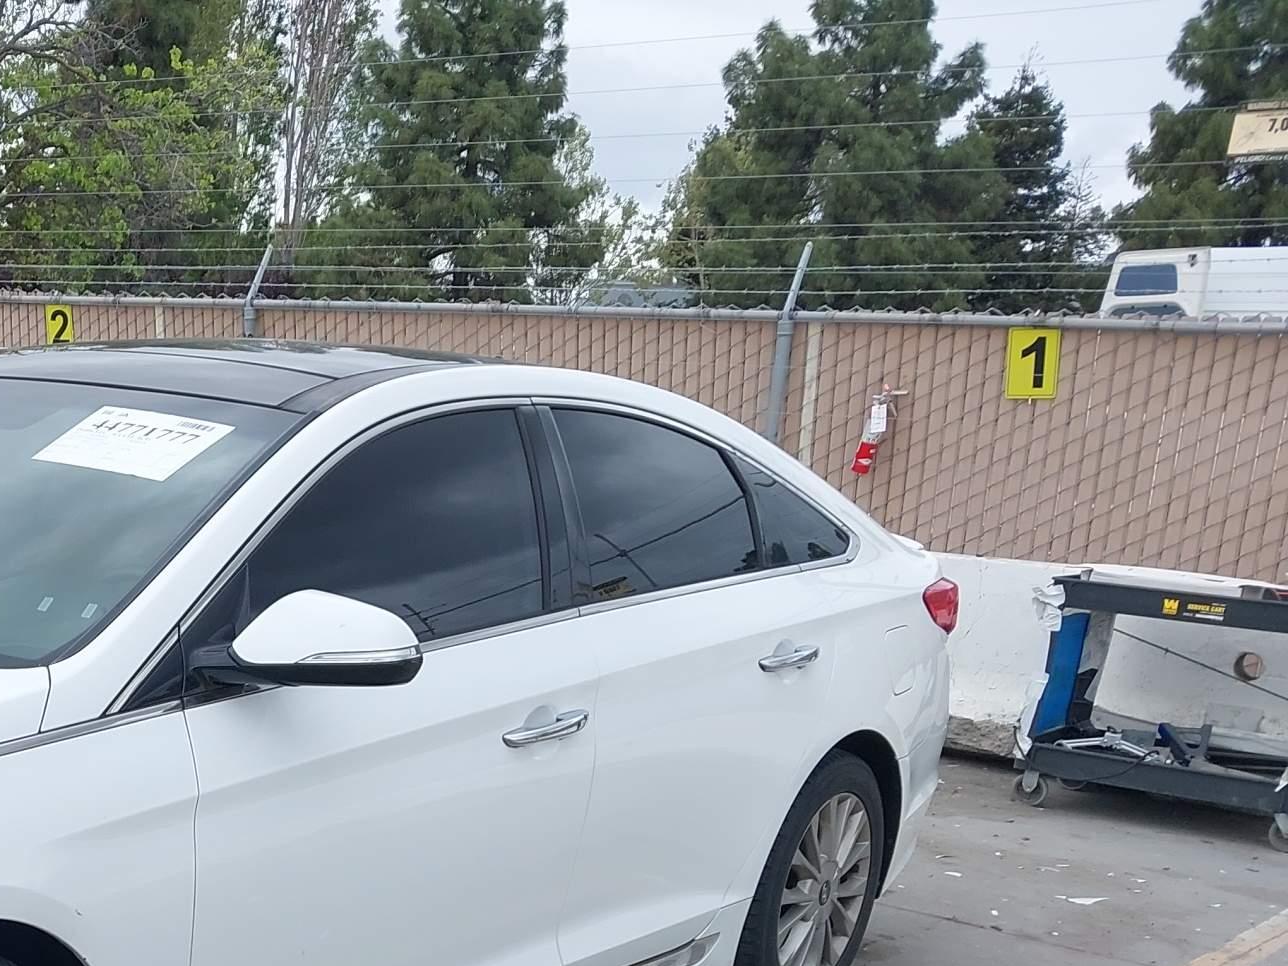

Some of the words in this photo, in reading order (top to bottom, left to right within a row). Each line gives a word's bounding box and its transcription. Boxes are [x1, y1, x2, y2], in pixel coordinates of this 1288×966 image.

[51, 310, 70, 344] 2
[1021, 336, 1047, 388] 1
[92, 419, 200, 445] 44771777
